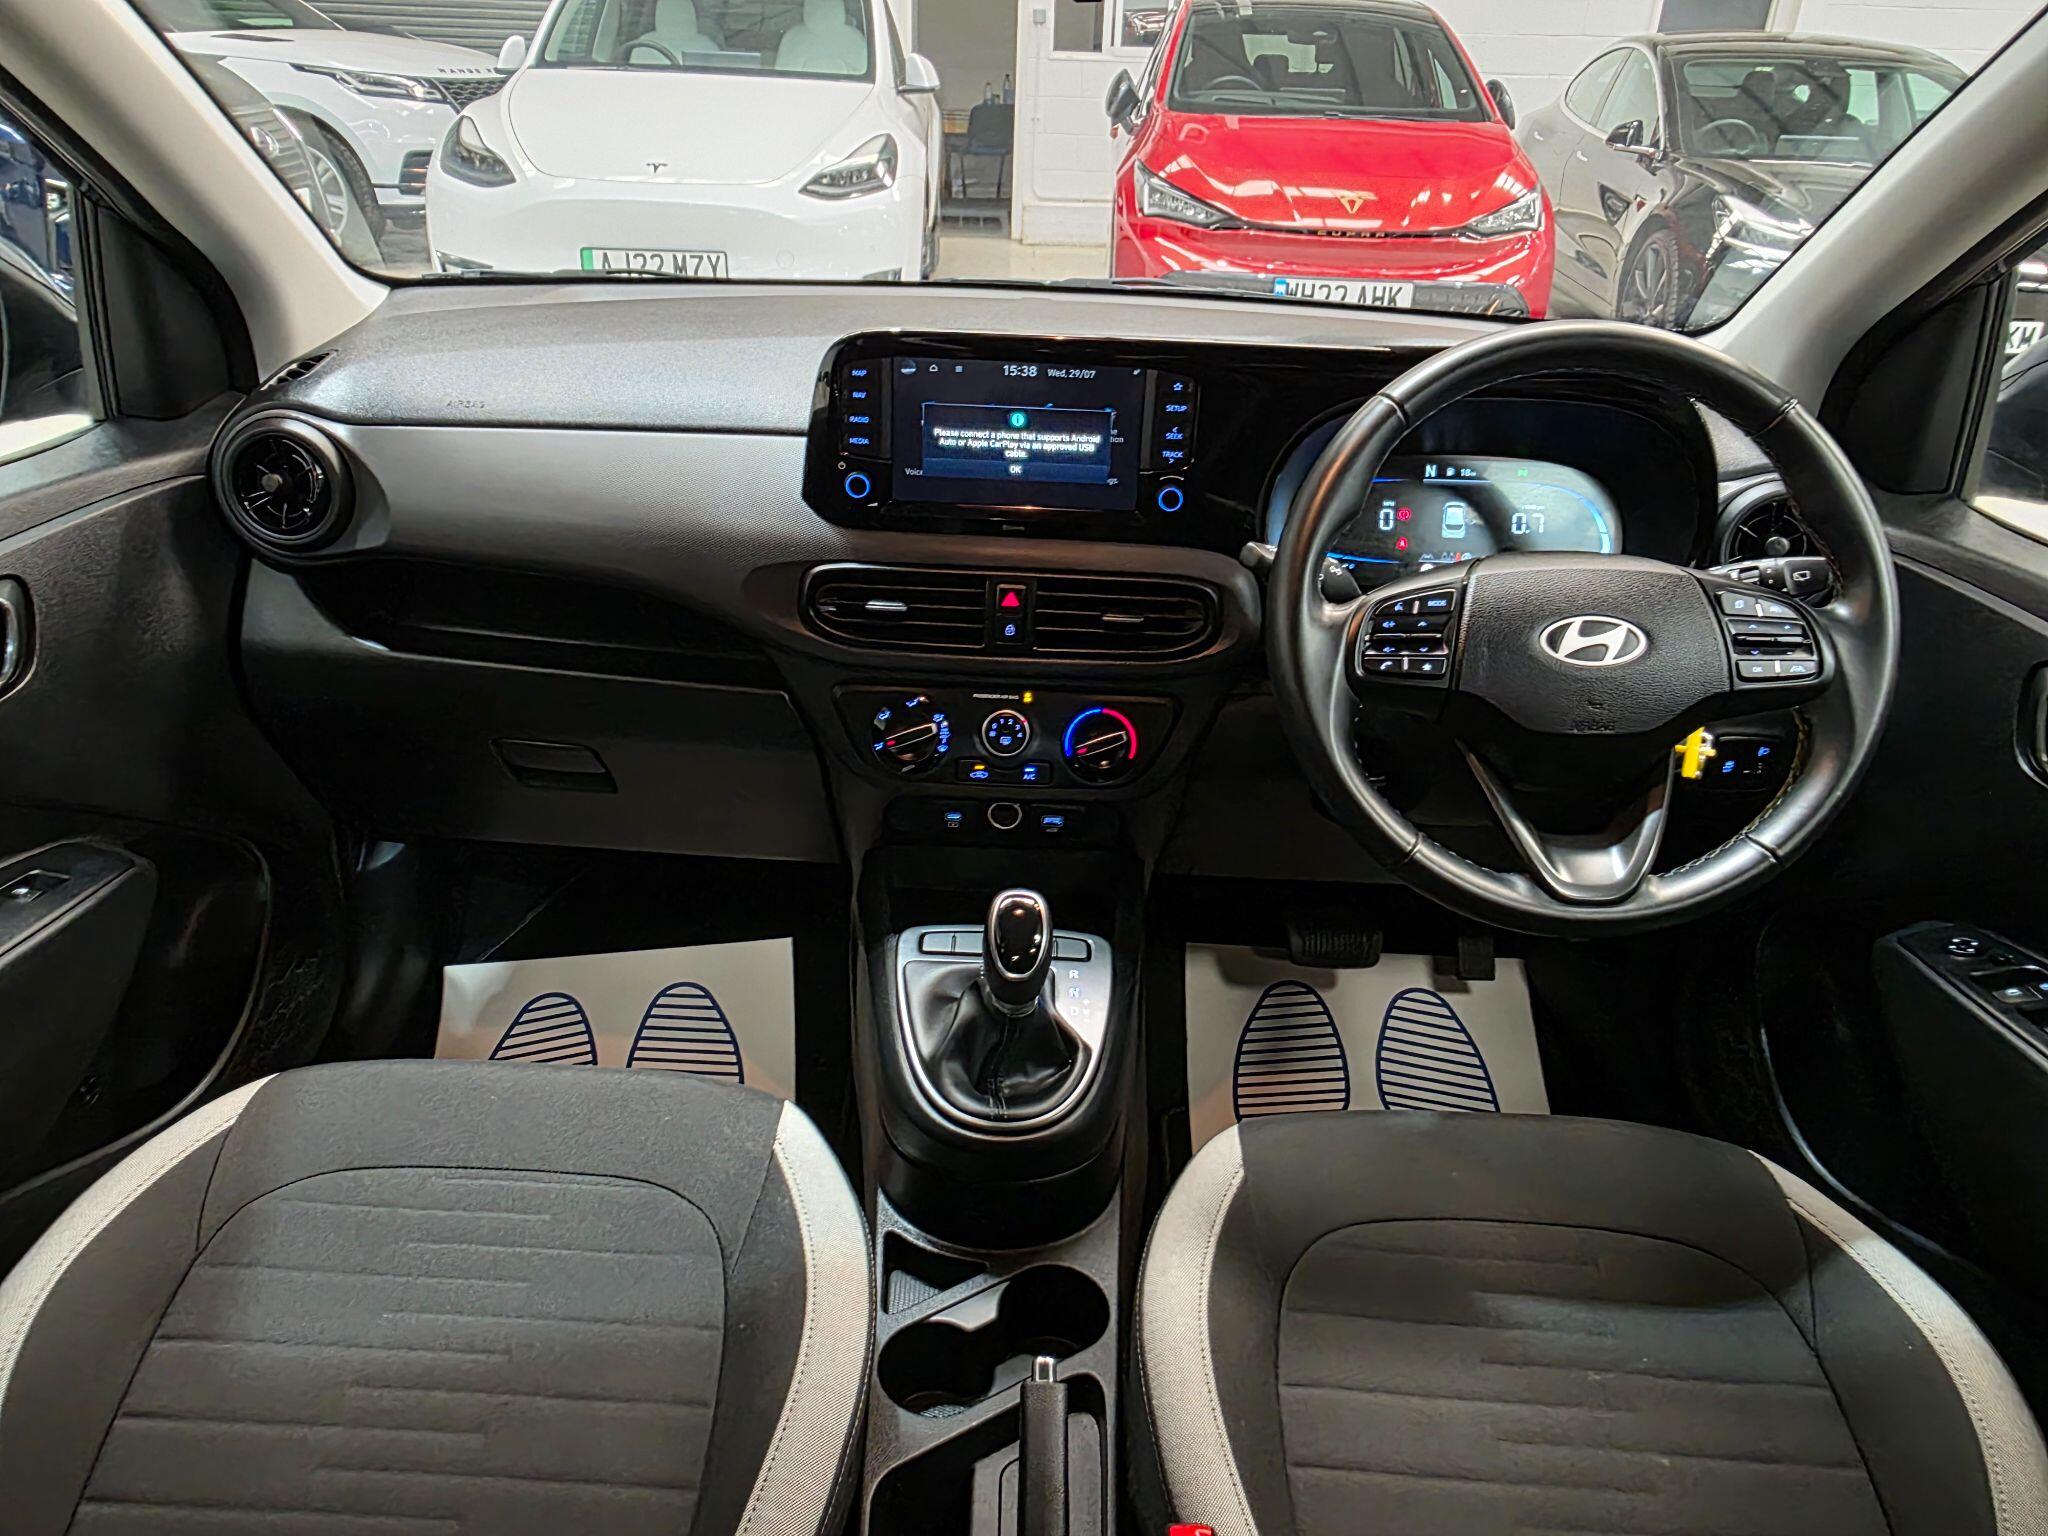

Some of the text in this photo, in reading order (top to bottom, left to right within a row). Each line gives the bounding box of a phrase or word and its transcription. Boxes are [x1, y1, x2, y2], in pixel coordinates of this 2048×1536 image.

[1002, 365, 1037, 377] 15:38
[1069, 369, 1096, 379] 29/07
[1165, 404, 1188, 412] SETUP
[849, 415, 870, 423] RADIO
[934, 428, 959, 437] Please
[960, 430, 989, 438] connect
[996, 432, 1020, 440] phone
[1037, 434, 1070, 442] supports
[1071, 435, 1100, 443] Android
[849, 437, 870, 445] MEDIA
[939, 438, 957, 446] Auto
[967, 440, 988, 448] Apple
[990, 440, 1018, 449] CarPlay
[1019, 441, 1031, 449] via
[1043, 443, 1077, 452] approved
[1162, 450, 1184, 458] TRACK
[1010, 465, 1022, 474] OK
[1425, 464, 1437, 478] N
[1069, 970, 1079, 979] R
